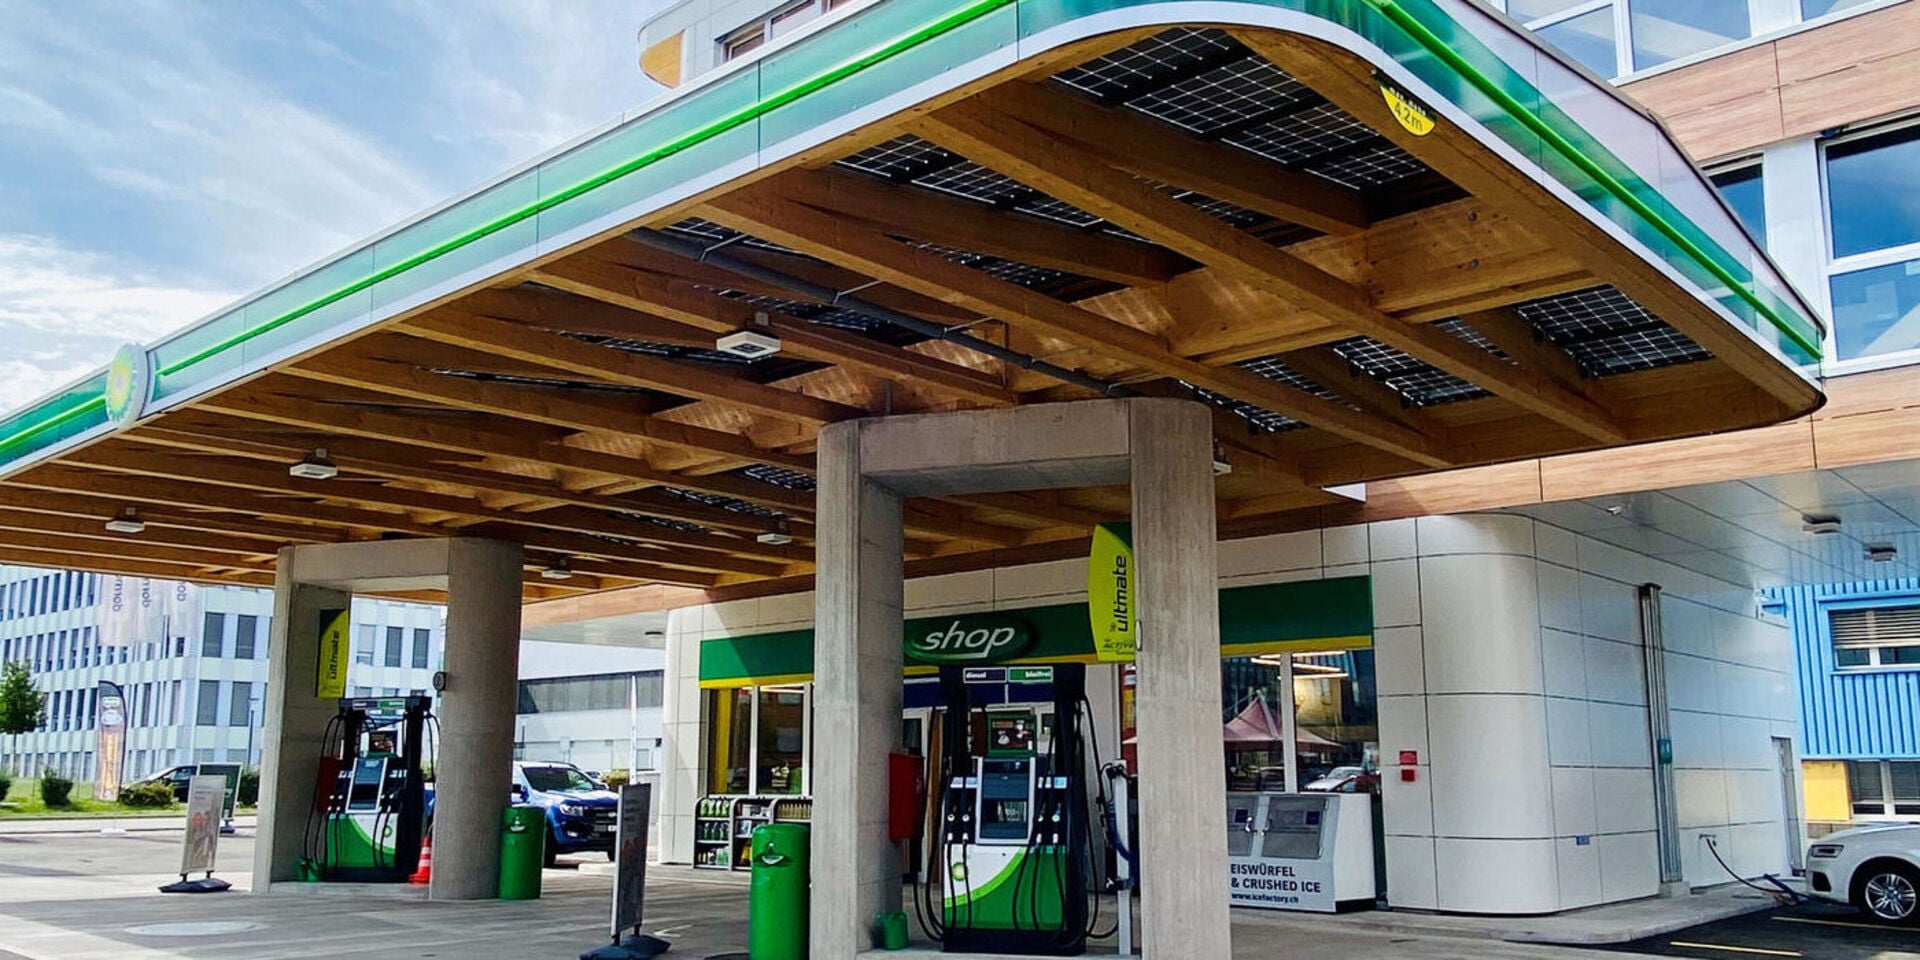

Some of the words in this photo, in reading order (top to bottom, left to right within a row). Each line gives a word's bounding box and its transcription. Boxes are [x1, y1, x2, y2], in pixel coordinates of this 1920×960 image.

[1112, 555, 1128, 632] ultimate
[924, 620, 1016, 658] shop
[1230, 863, 1296, 877] EISWÜRFEL
[1231, 877, 1240, 888] &
[1242, 878, 1298, 891] CRUSHED
[1301, 881, 1321, 893] ICE
